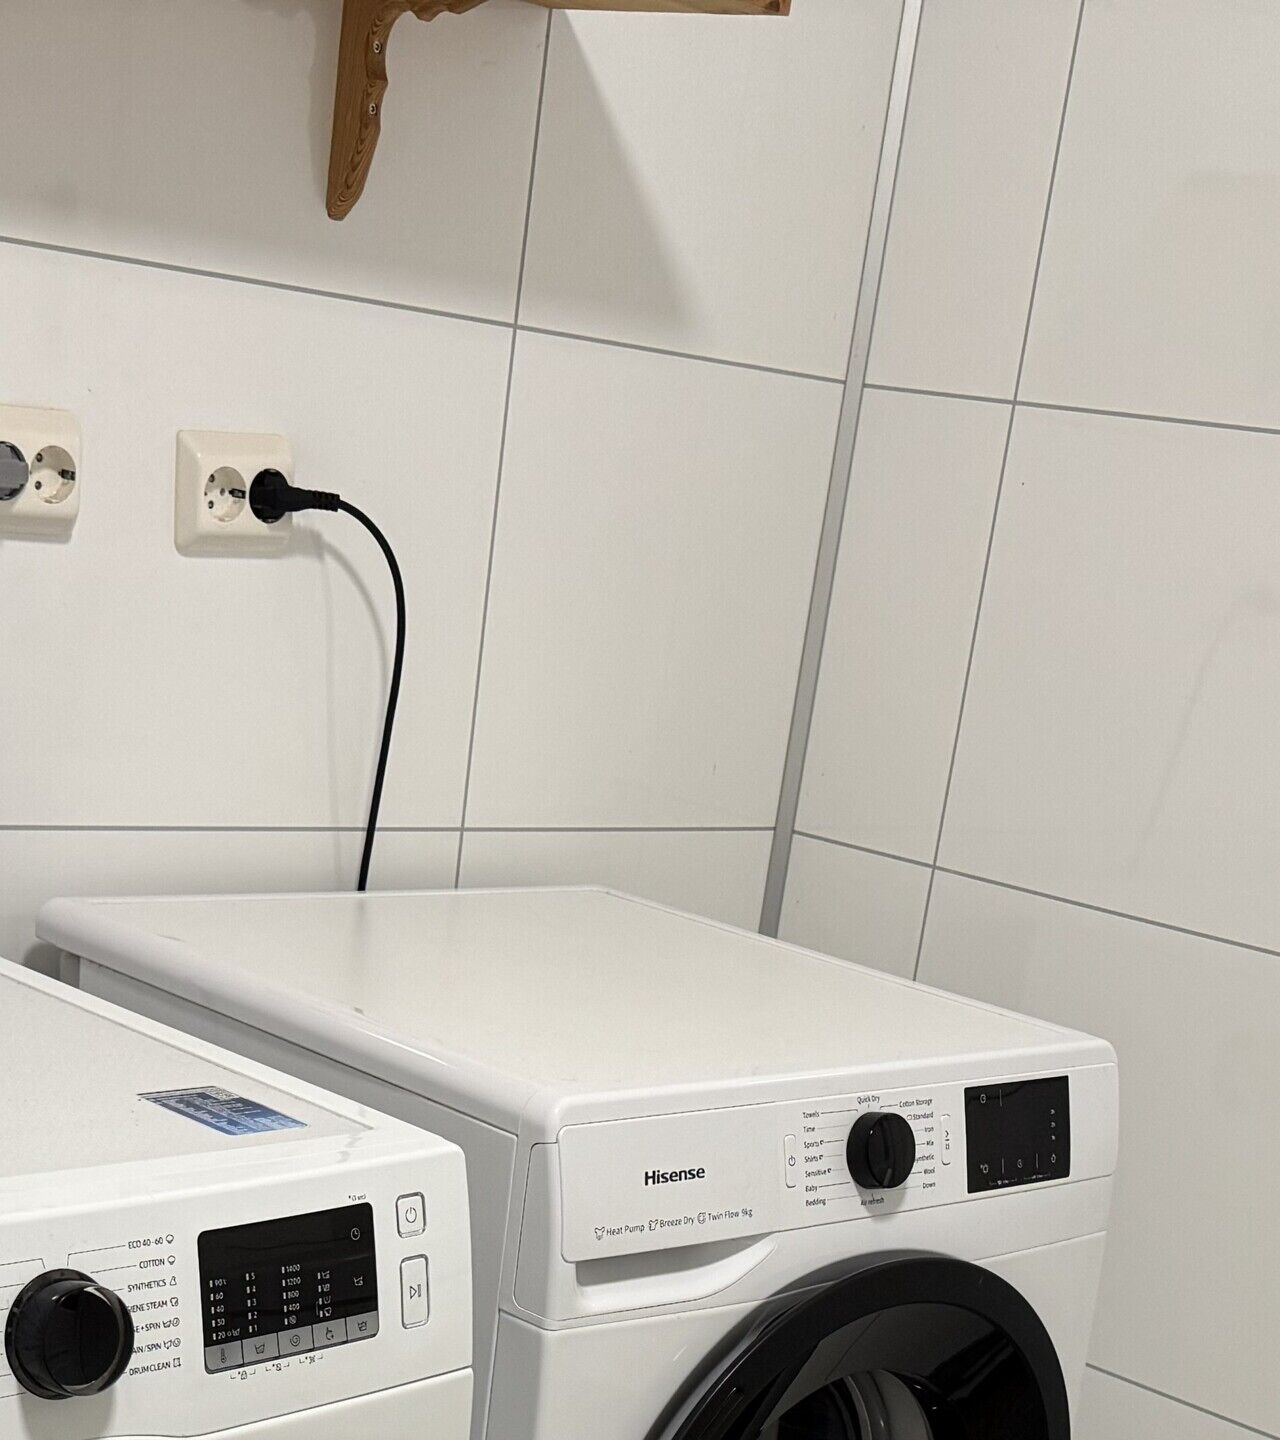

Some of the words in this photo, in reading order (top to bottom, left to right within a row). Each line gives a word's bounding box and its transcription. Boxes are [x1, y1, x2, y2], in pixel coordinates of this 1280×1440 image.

[912, 1111, 934, 1121] Standard
[915, 1154, 935, 1164] ynthetic
[644, 1166, 706, 1187] Hisense
[922, 1182, 936, 1190] Down
[805, 1197, 827, 1207] Bedding
[606, 1226, 624, 1237] Heat
[624, 1223, 646, 1234] Pump
[659, 1217, 682, 1229] Breeze
[683, 1215, 695, 1226] Dry
[708, 1210, 724, 1222] Twin
[724, 1208, 740, 1220] Flow
[128, 1239, 141, 1250] ECO
[139, 1258, 165, 1270] COTTON
[127, 1279, 167, 1293] SYNTHETICS
[146, 1299, 167, 1311] STEAM
[129, 1364, 149, 1376] DRUM
[150, 1361, 171, 1372] CLEAN
